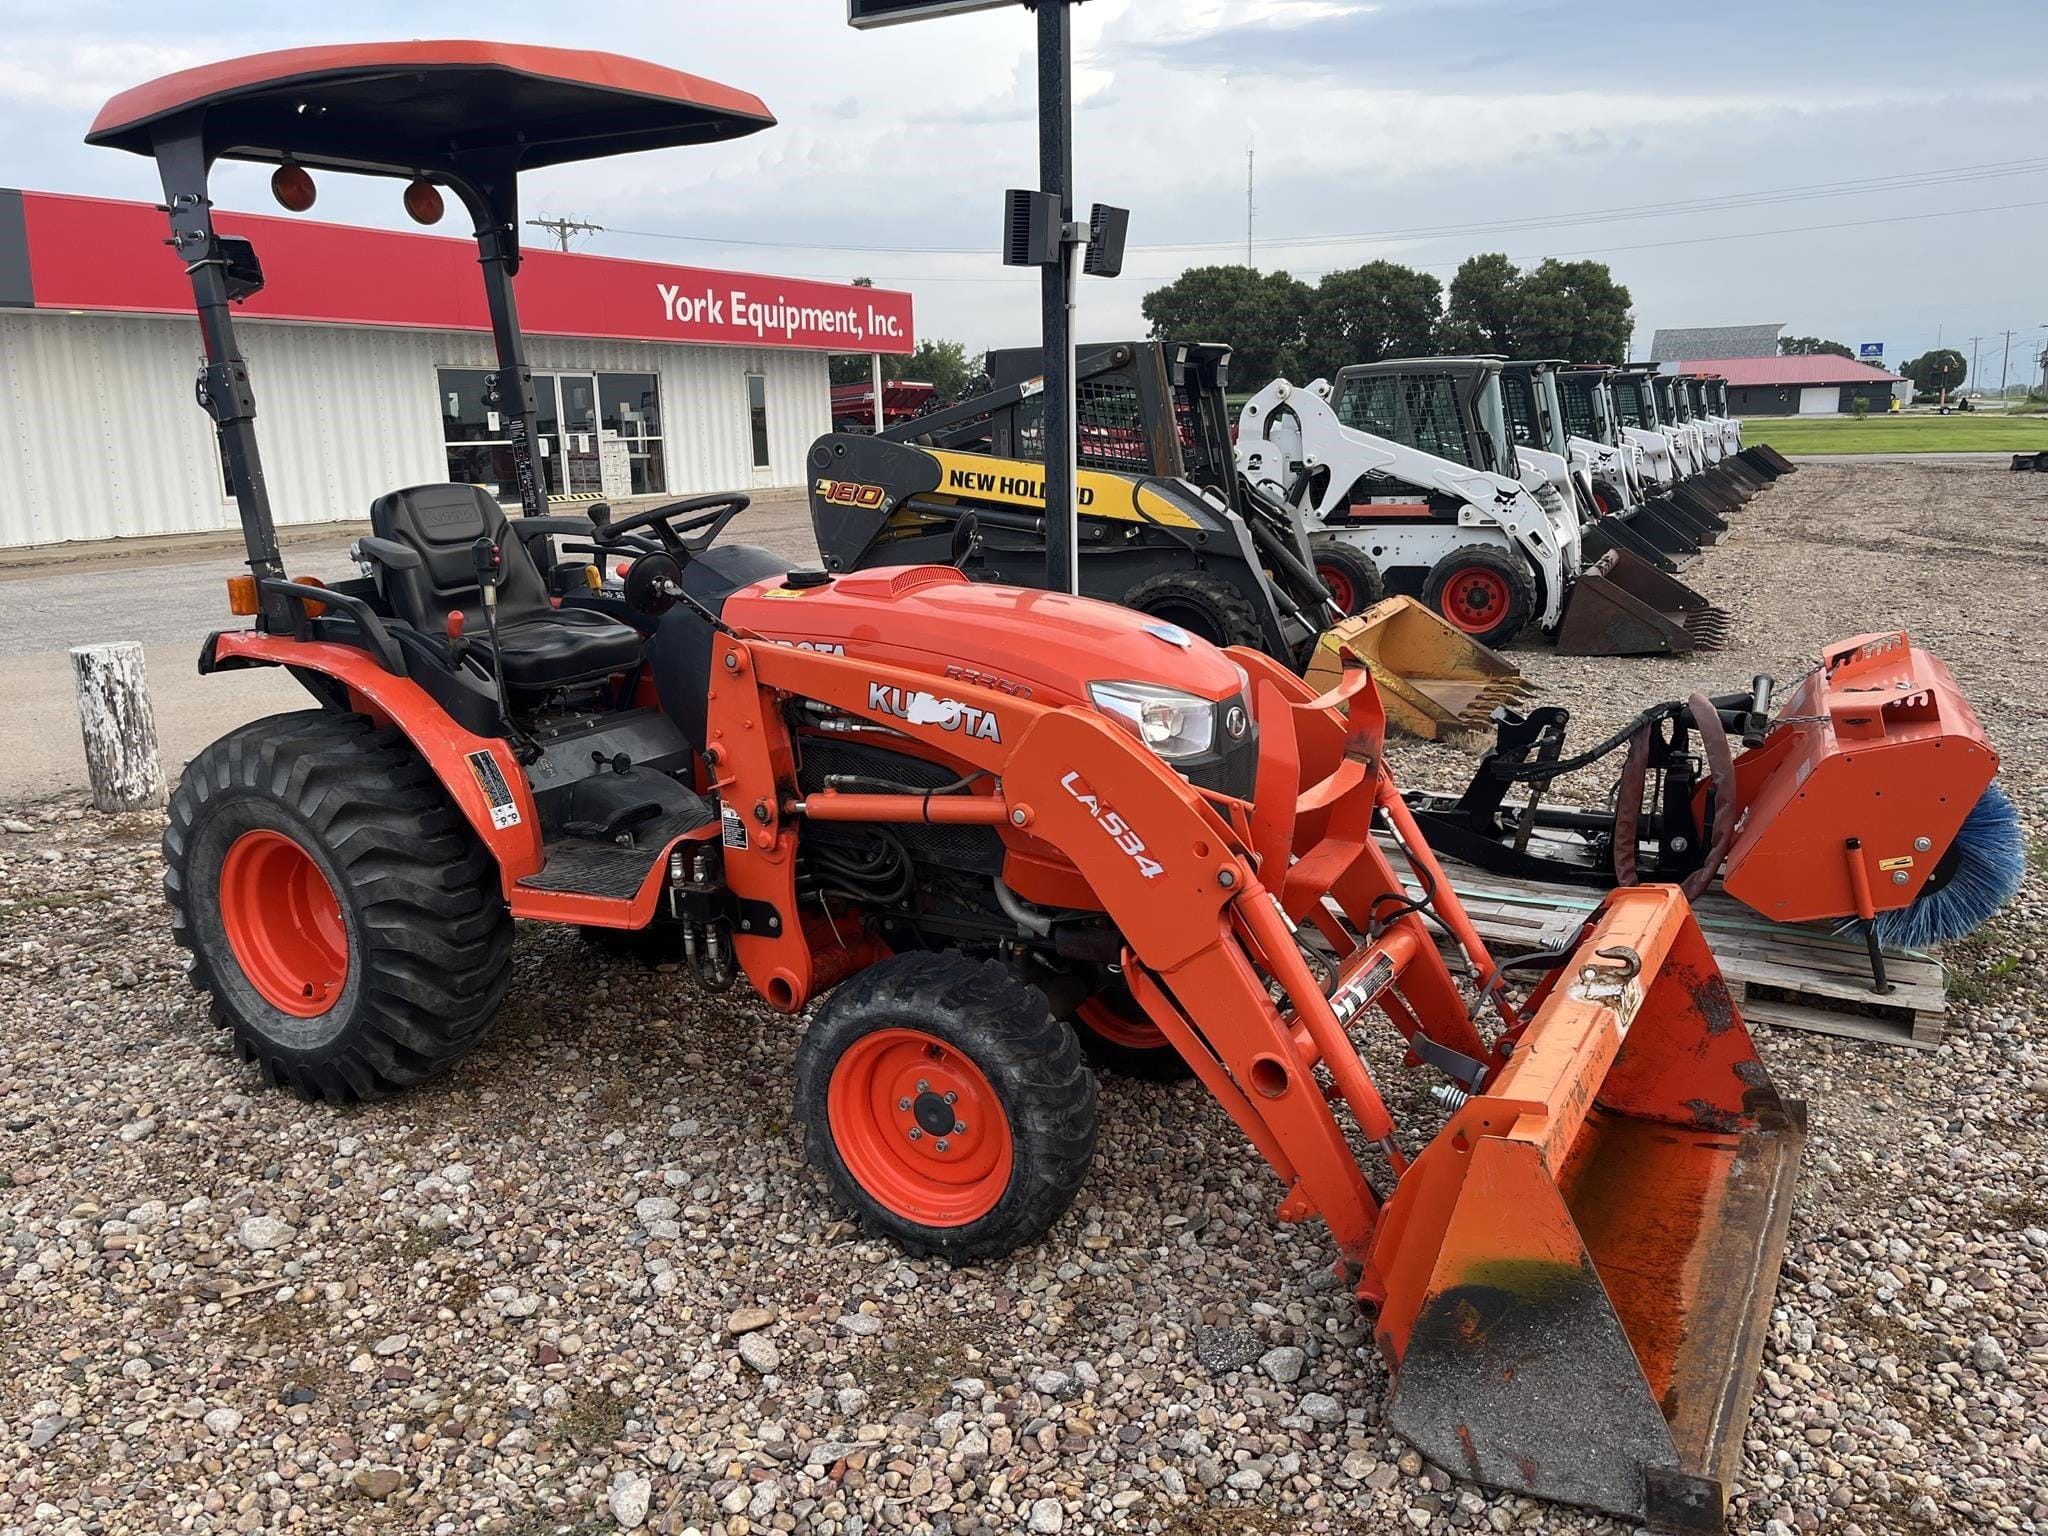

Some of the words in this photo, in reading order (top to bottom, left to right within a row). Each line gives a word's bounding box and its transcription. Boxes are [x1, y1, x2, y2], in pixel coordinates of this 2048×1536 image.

[657, 283, 724, 324] York
[731, 291, 863, 340] Equipment,
[867, 304, 903, 337] Inc.
[949, 470, 998, 491] NEW
[1000, 476, 1095, 506] HOLLD
[868, 681, 1002, 744] KUOTA
[1061, 770, 1164, 879] LA534
